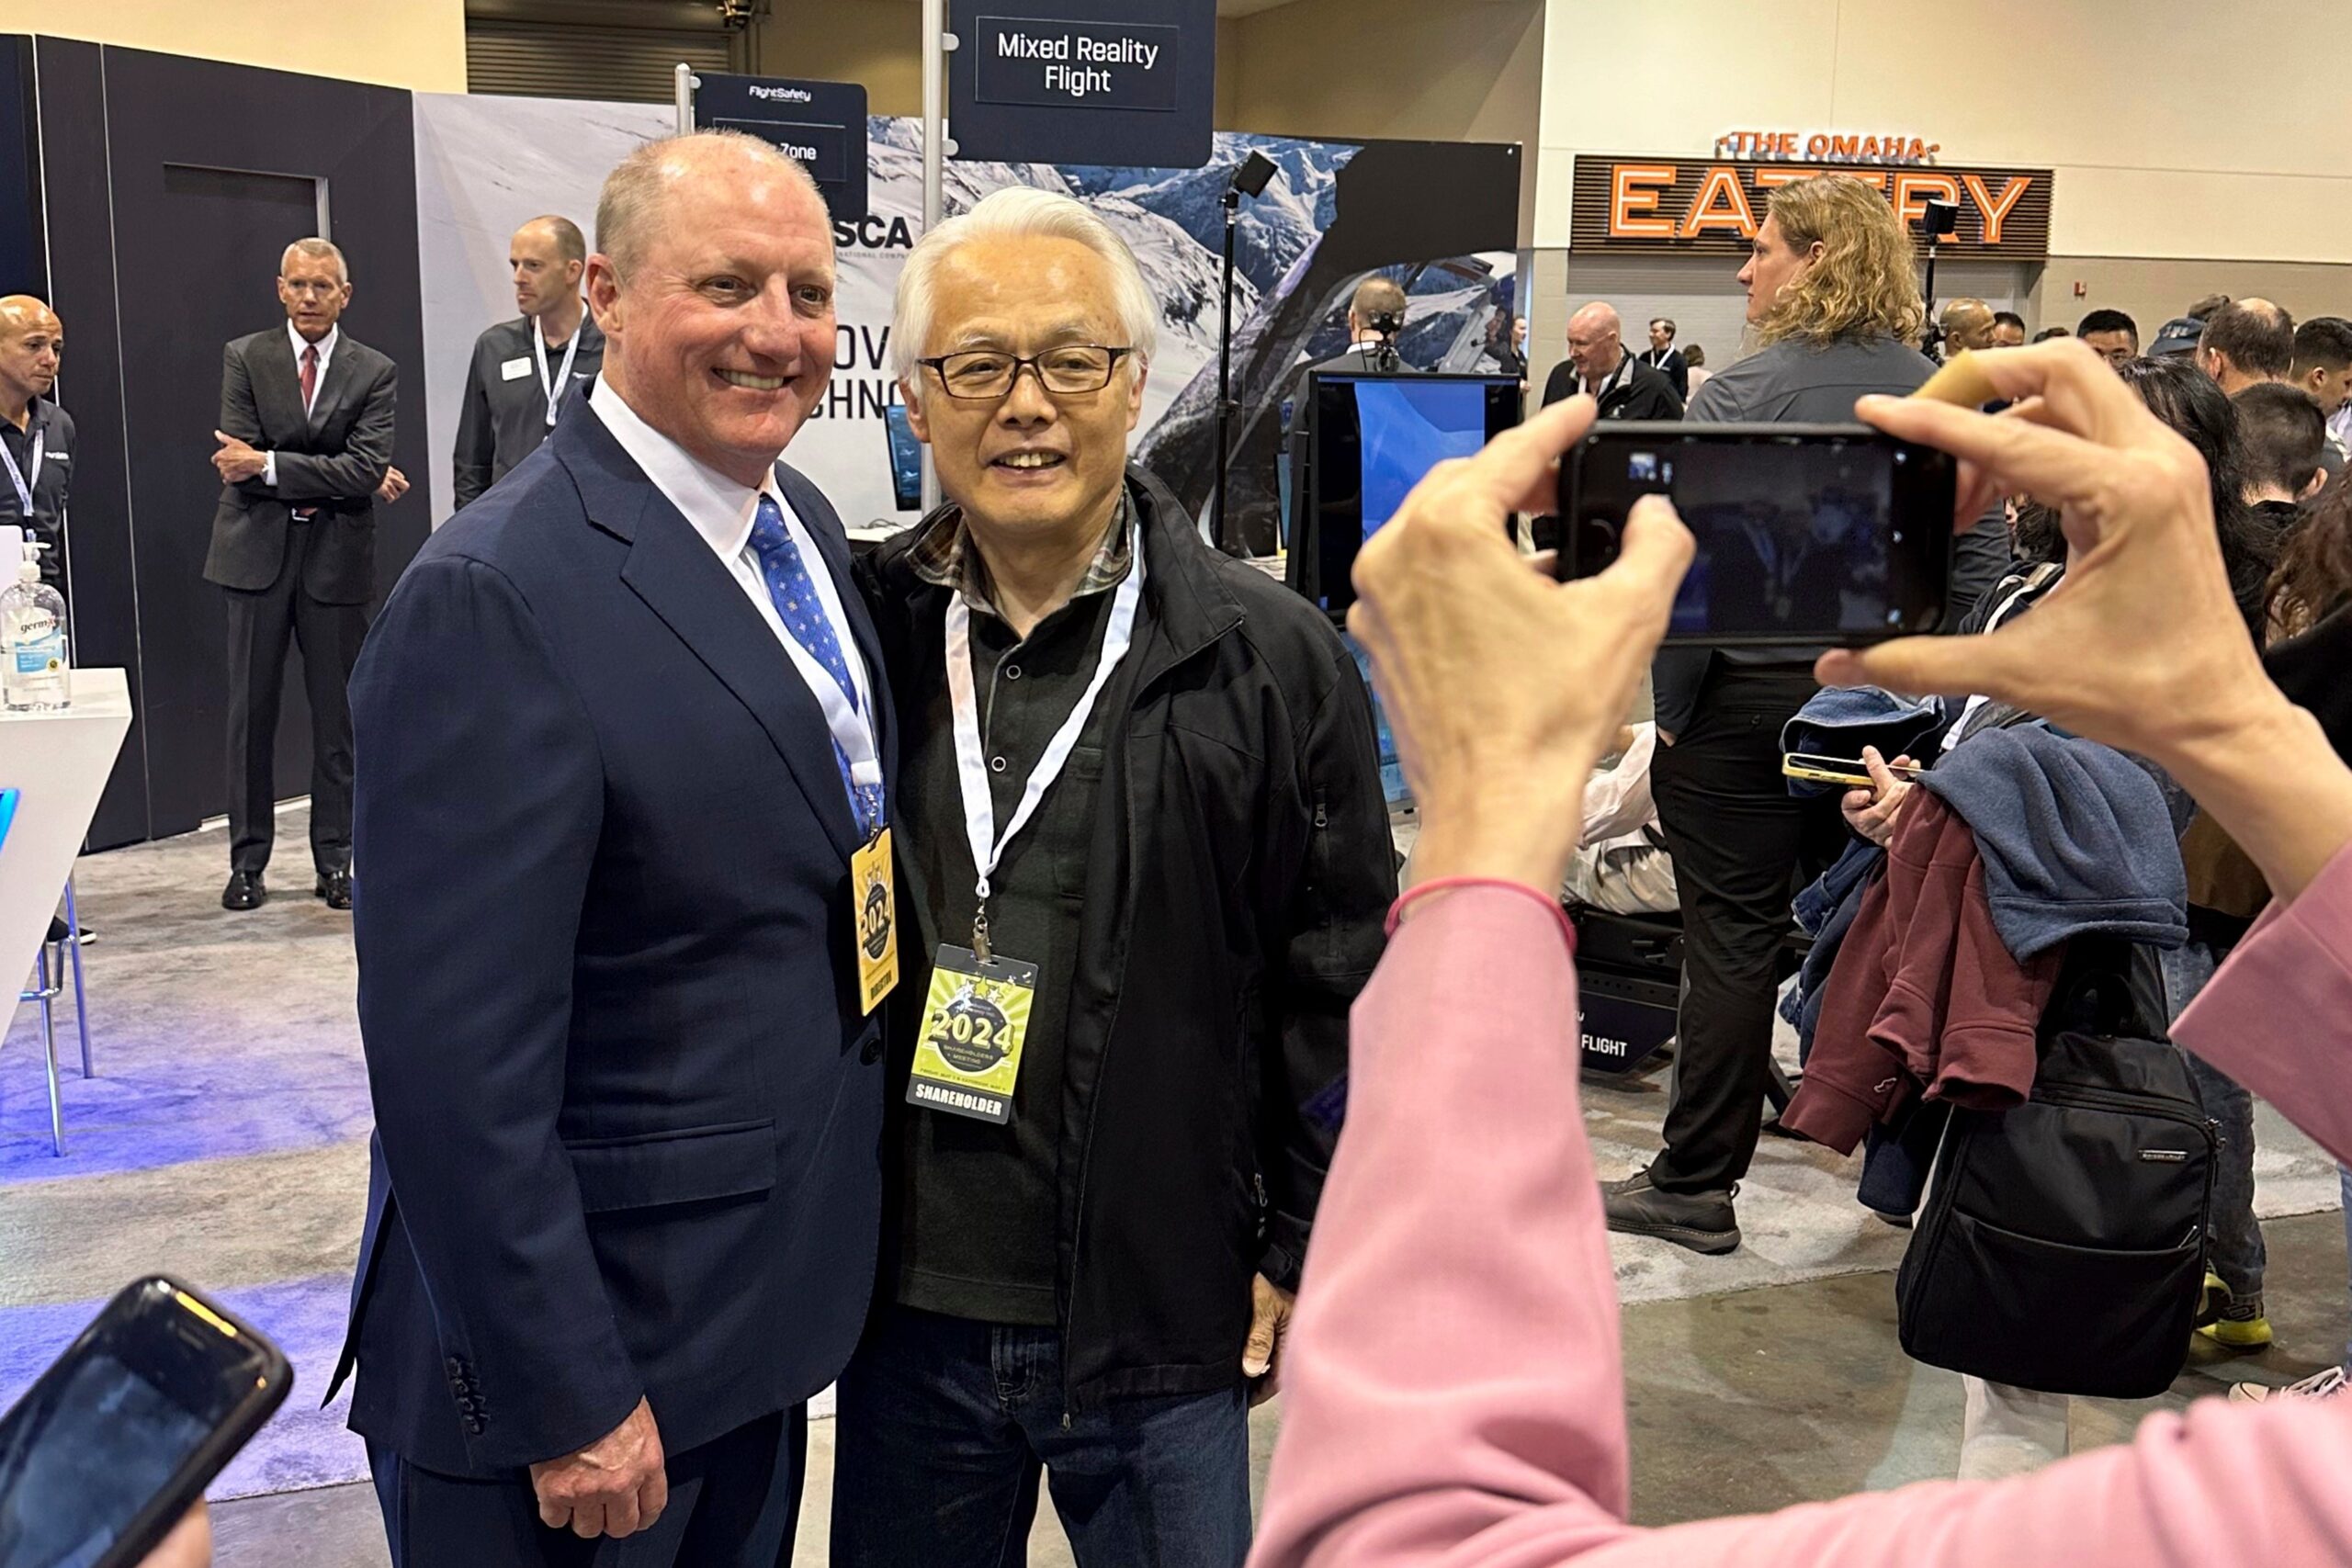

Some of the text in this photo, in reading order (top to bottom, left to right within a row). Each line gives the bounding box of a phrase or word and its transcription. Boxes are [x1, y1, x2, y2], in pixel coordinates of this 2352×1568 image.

[998, 32, 1159, 70] Mixed Reality
[749, 85, 811, 102] FlightSafety
[1045, 64, 1112, 96] Flight
[1731, 131, 1928, 158] THE OMAHA
[1610, 165, 2032, 243] EARY
[833, 216, 913, 249] SCA
[833, 324, 890, 370] OV
[930, 1008, 1014, 1055] 2024
[1581, 1034, 1627, 1056] FLIGHT
[915, 1083, 1002, 1116] SHAREHOLDER
